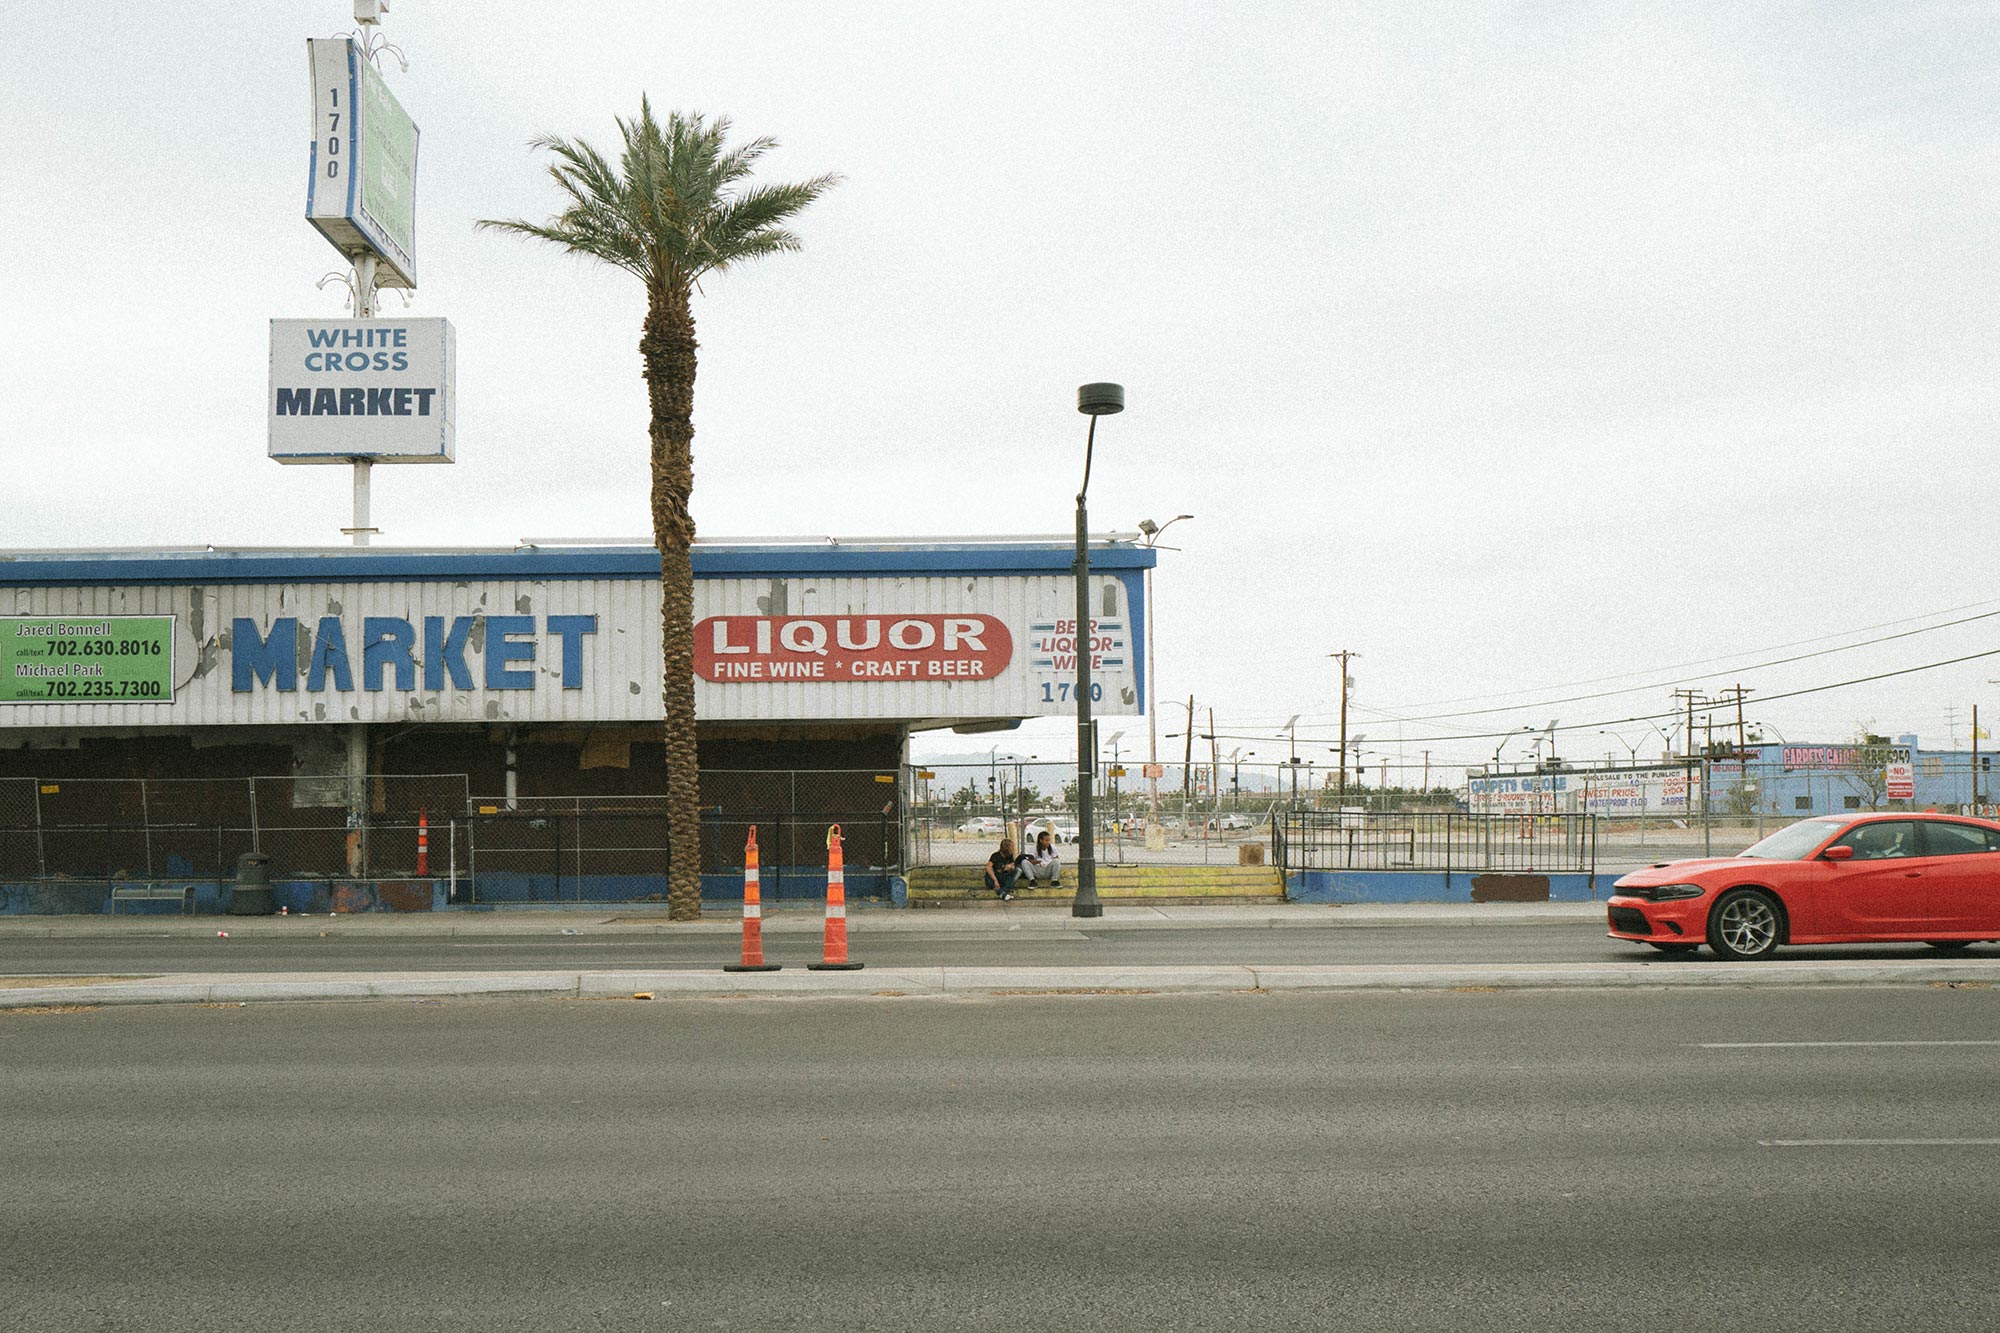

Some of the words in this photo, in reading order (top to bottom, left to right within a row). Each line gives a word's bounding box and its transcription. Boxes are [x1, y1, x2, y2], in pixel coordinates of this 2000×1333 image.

[328, 88, 340, 178] 1700
[307, 329, 407, 347] WHITE
[304, 352, 408, 372] CROSS
[276, 388, 437, 416] MARKET
[16, 623, 54, 637] Jared
[58, 622, 111, 636] Bonnell
[1055, 620, 1097, 634] BER
[713, 618, 987, 656] LIQUOR
[16, 649, 45, 657] call/text
[47, 640, 161, 656] 702.630.8016
[232, 614, 598, 691] MARKET
[16, 663, 69, 677] Michael
[73, 663, 104, 677] Park
[714, 662, 762, 678] FINE
[769, 662, 824, 678] WINE
[851, 660, 920, 676] CRAFT
[928, 659, 984, 675] BEER
[1053, 655, 1102, 670] WIE
[16, 690, 44, 698] call/text
[46, 681, 161, 697] 702.235.7300
[1893, 767, 1904, 775] NO
[1471, 779, 1517, 793] CAPETS
